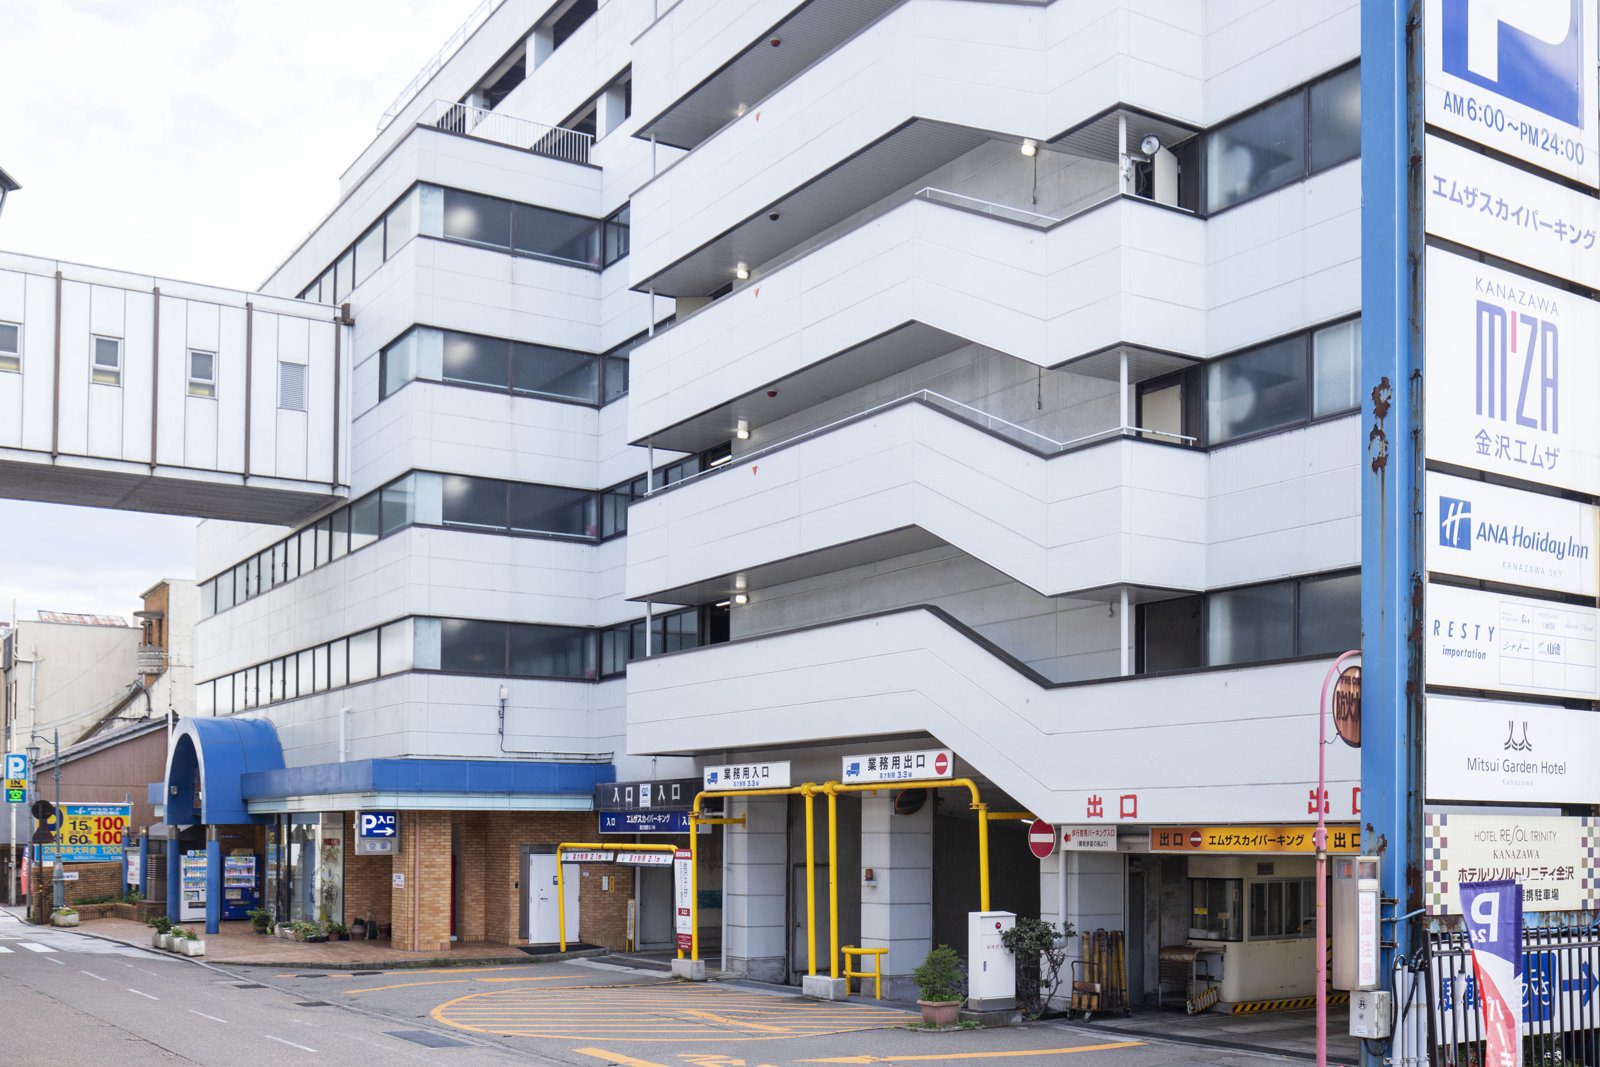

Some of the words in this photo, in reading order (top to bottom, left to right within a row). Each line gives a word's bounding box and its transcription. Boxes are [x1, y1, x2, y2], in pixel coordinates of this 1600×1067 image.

[1432, 175, 1596, 250] エムザスカイパーキング
[1475, 276, 1559, 316] KANAZAWA
[1475, 429, 1560, 470] 金沢エムザ
[1476, 522, 1509, 546] ANA
[1512, 525, 1567, 561] Holiday
[1567, 536, 1589, 560] Inn
[1502, 561, 1545, 576] KANAZAWA
[1549, 569, 1563, 578] SKY
[1433, 619, 1495, 642] RESTY
[1442, 645, 1487, 660] importation
[867, 754, 925, 771] 業務用出口
[1467, 757, 1500, 773] Mitsui
[1502, 759, 1538, 774] Garden
[1541, 761, 1567, 775] Hotel
[723, 766, 769, 780] 業務用入口
[613, 787, 633, 802] 入口
[658, 784, 680, 800] 入口
[1086, 793, 1138, 819] 出口
[361, 814, 377, 836] P
[378, 815, 395, 824] 入口
[606, 817, 616, 826] 入口
[682, 816, 690, 825] 入
[1160, 832, 1183, 846] 出口
[1208, 834, 1304, 846] エムザスカイパーキング
[1474, 830, 1497, 842] HOTEL
[1530, 831, 1557, 842] TRINITY
[1493, 849, 1540, 859] KANAZAWA
